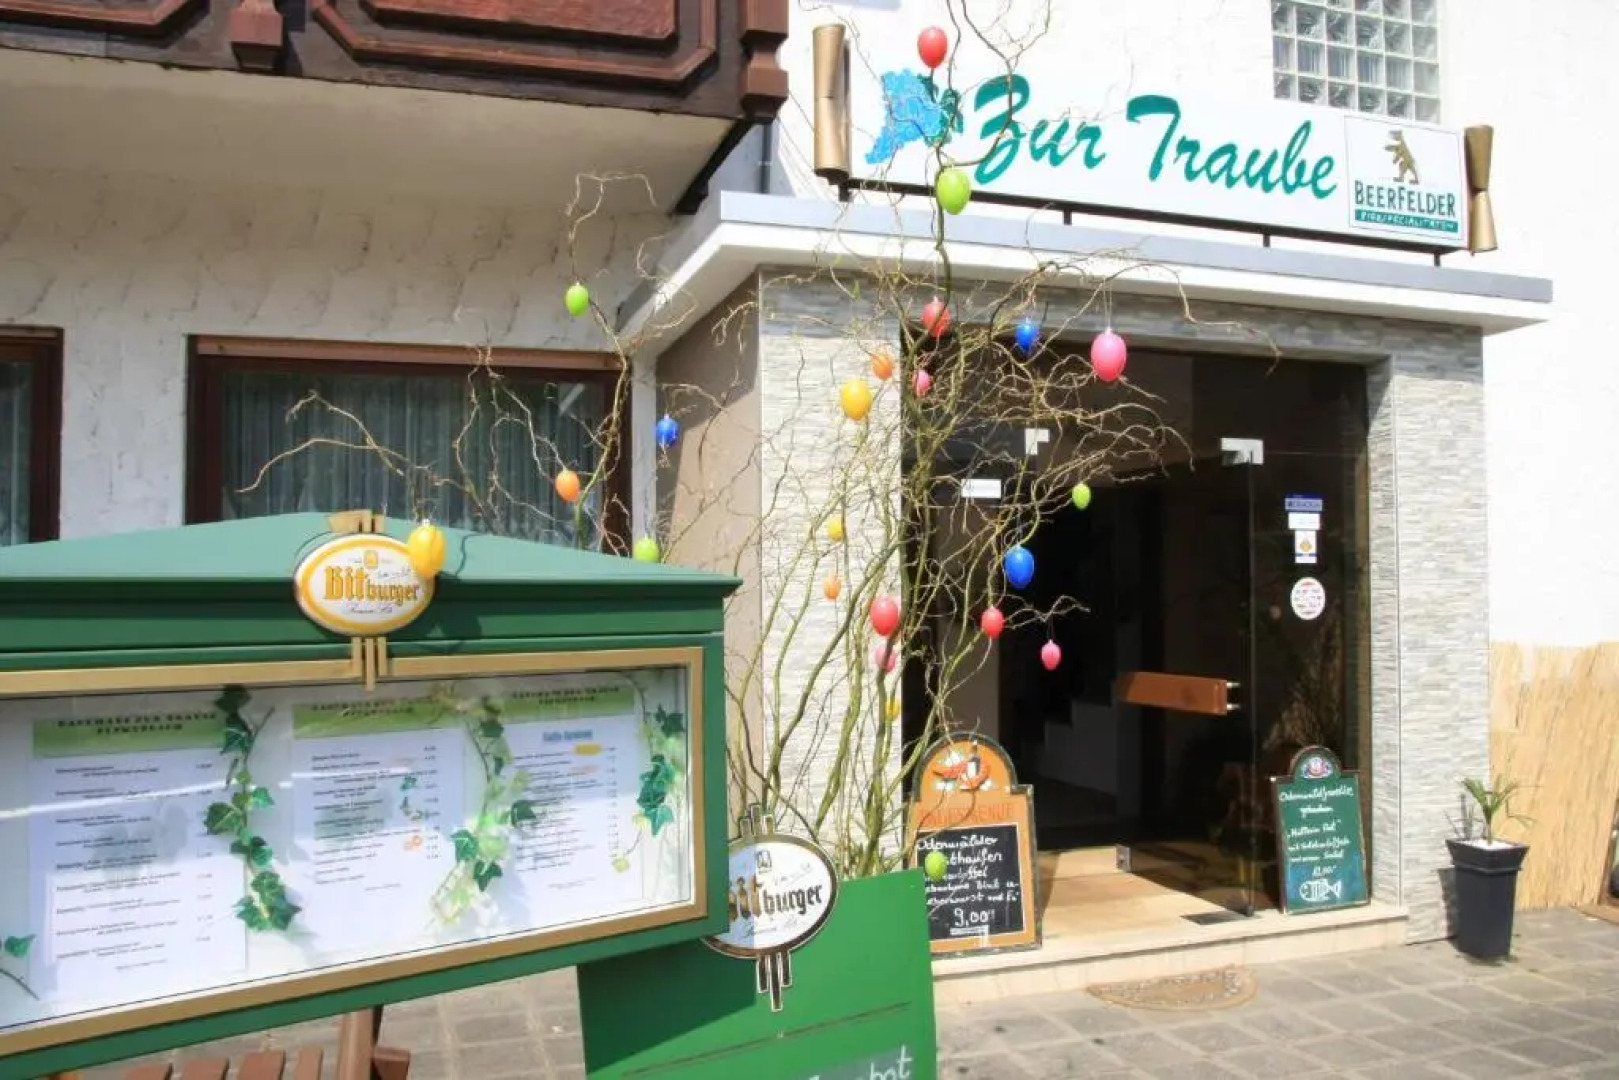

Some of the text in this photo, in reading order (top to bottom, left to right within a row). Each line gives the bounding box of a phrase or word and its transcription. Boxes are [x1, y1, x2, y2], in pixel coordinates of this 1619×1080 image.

[974, 74, 1338, 199] Zur Traube
[1354, 180, 1455, 217] BEERFELDER
